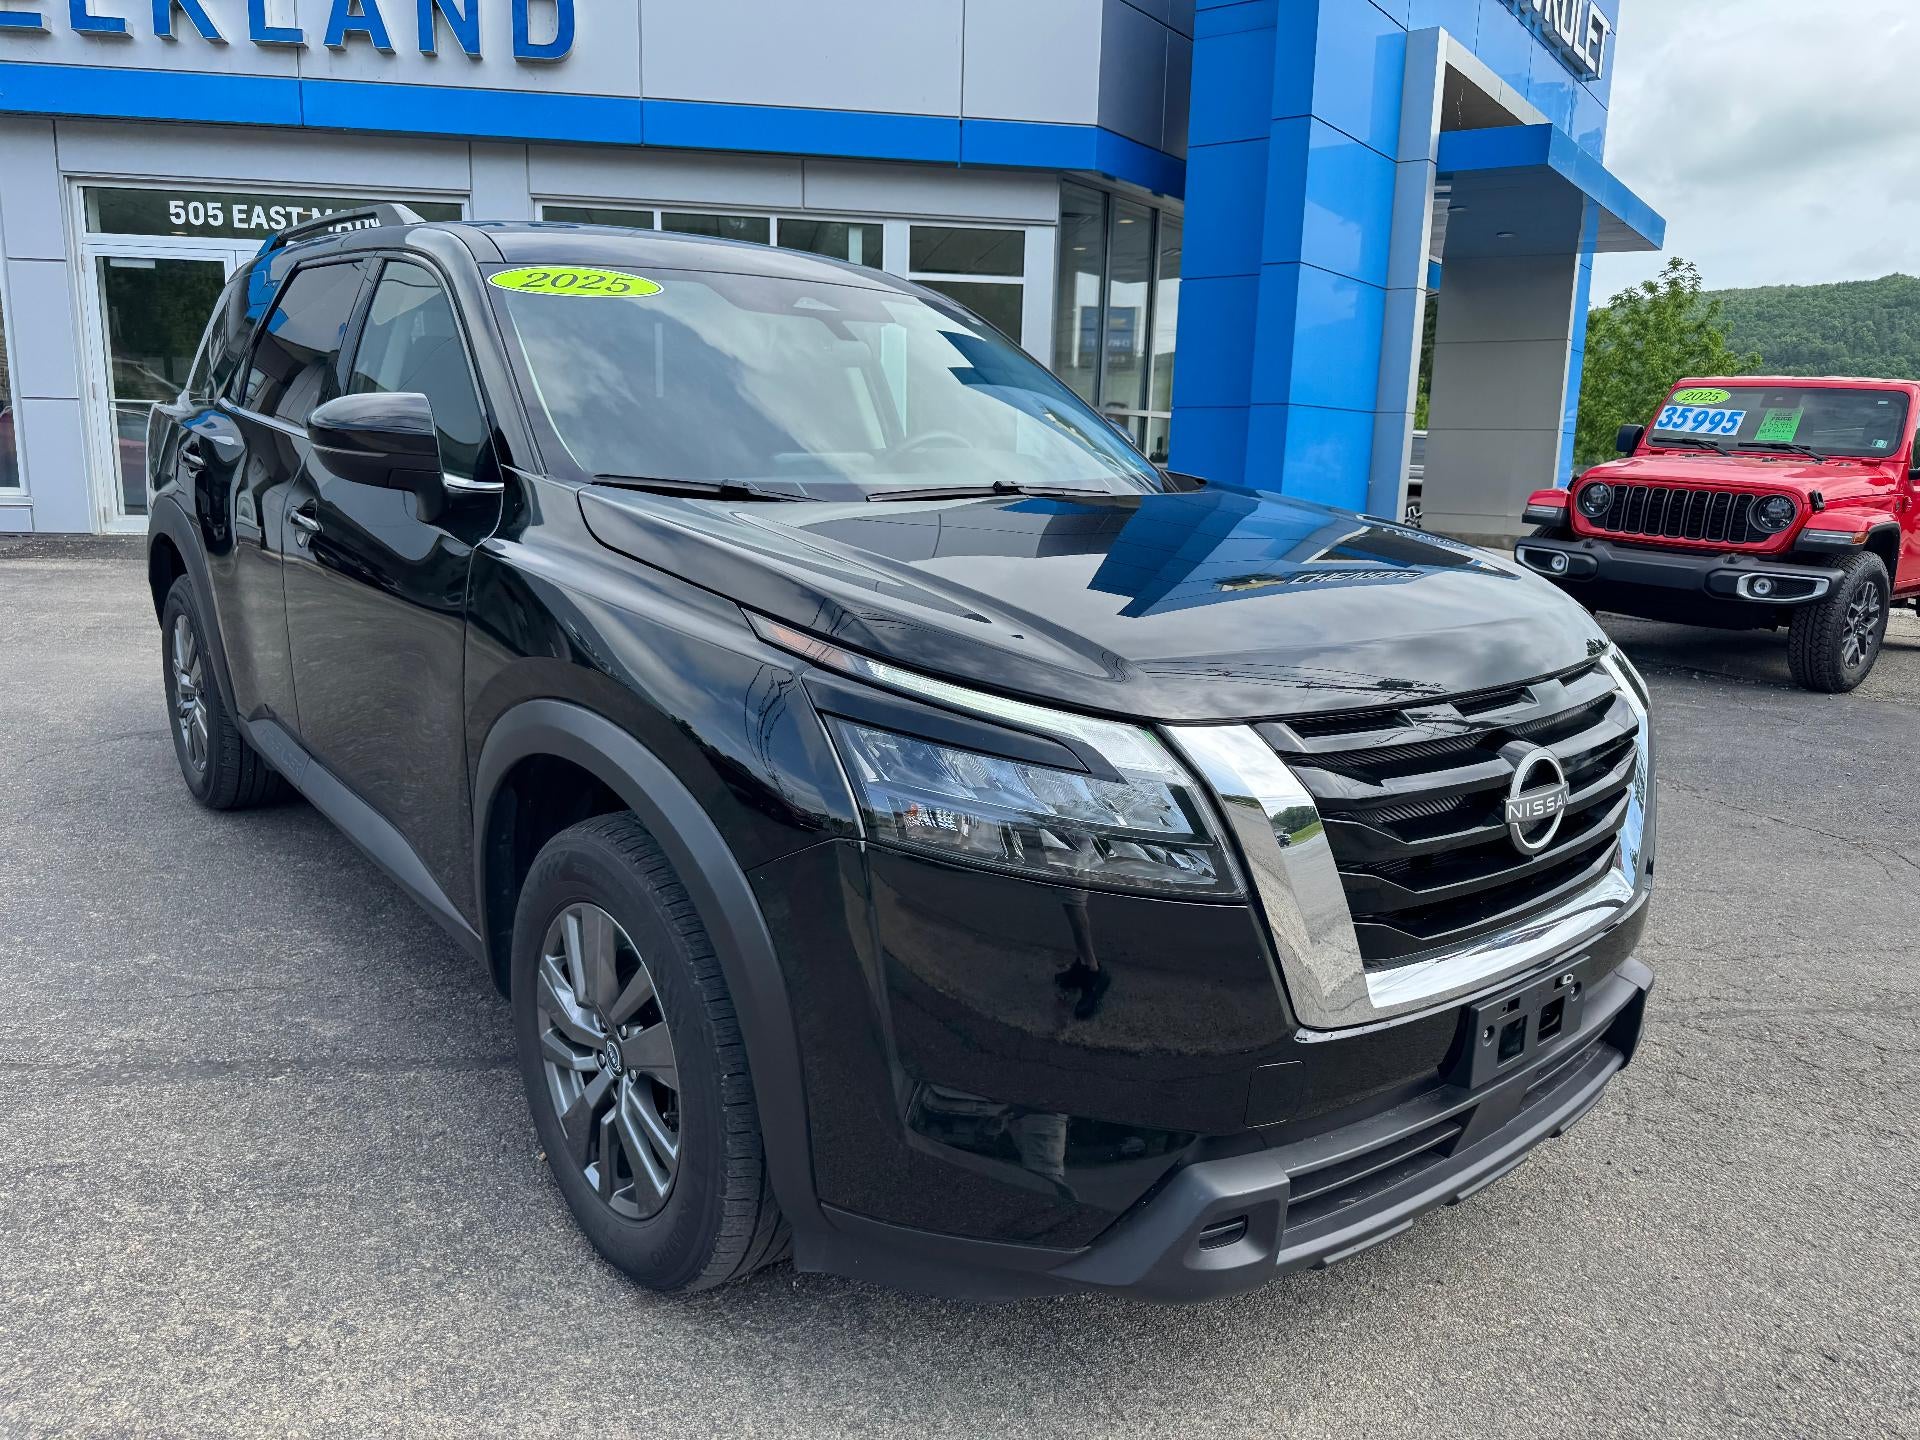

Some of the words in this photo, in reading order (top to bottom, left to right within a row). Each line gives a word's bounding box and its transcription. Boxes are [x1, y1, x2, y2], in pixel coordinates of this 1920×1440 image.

[0, 0, 575, 63] LAND
[1533, 0, 1612, 80] OLET
[169, 201, 224, 226] 505
[232, 204, 303, 230] EAST
[520, 272, 634, 293] 2025
[1682, 392, 1722, 402] 2025
[1657, 406, 1744, 433] 35995
[1508, 791, 1569, 820] NISSAN
